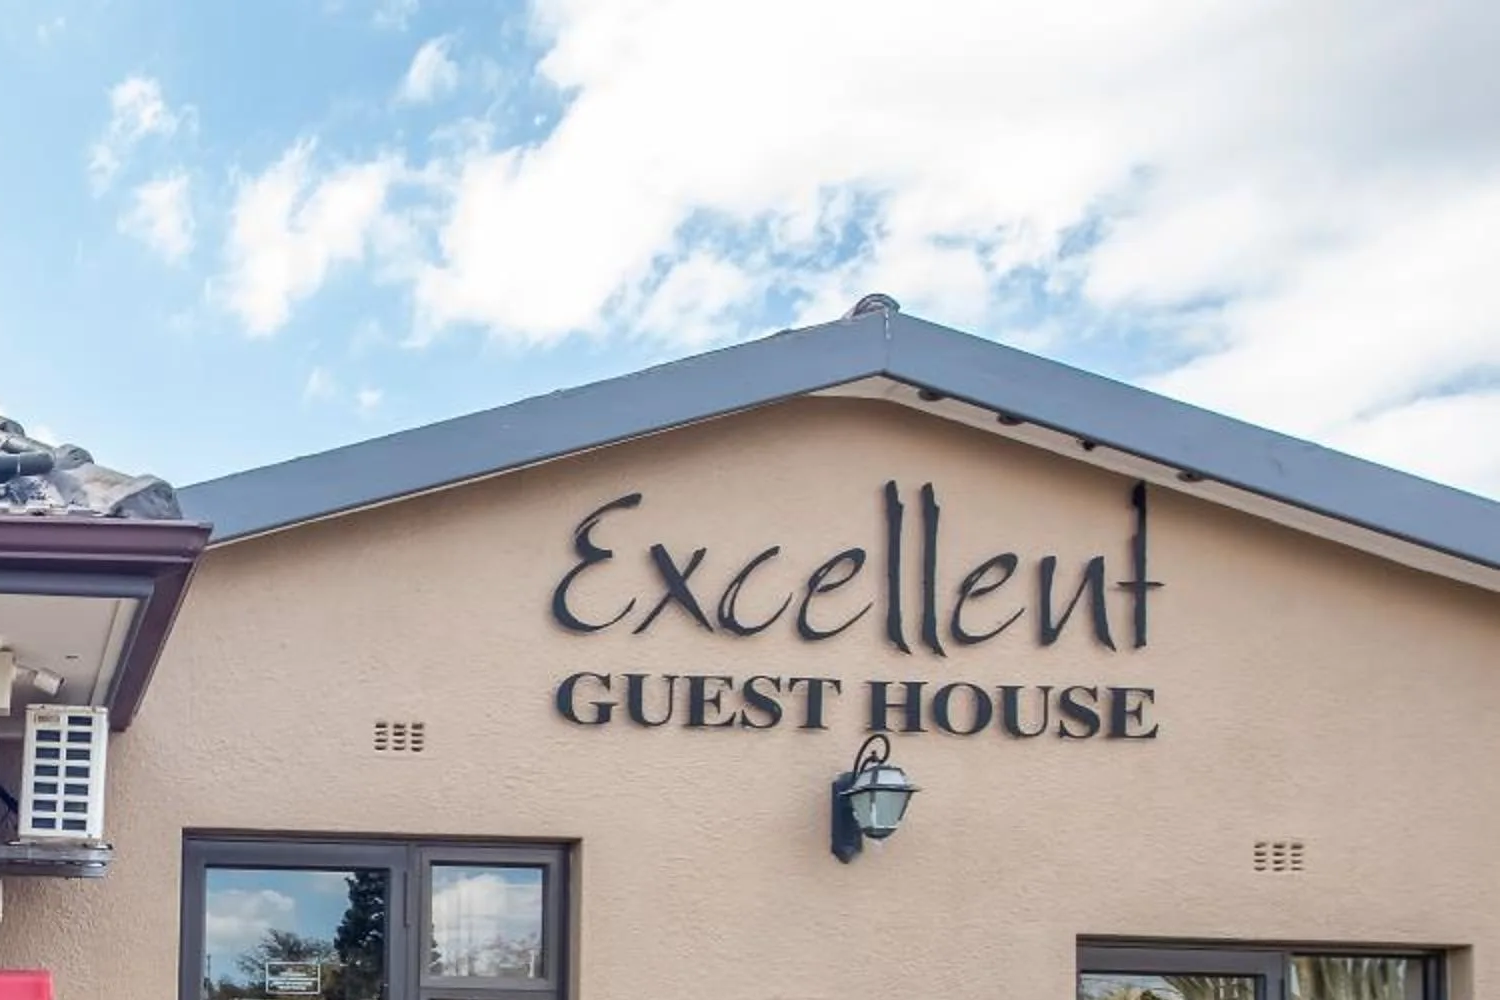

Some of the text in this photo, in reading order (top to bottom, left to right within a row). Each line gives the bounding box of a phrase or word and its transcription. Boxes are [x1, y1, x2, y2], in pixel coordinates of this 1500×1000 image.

[551, 480, 1165, 657] Excellent
[556, 671, 1159, 738] GUEST HOUSE
